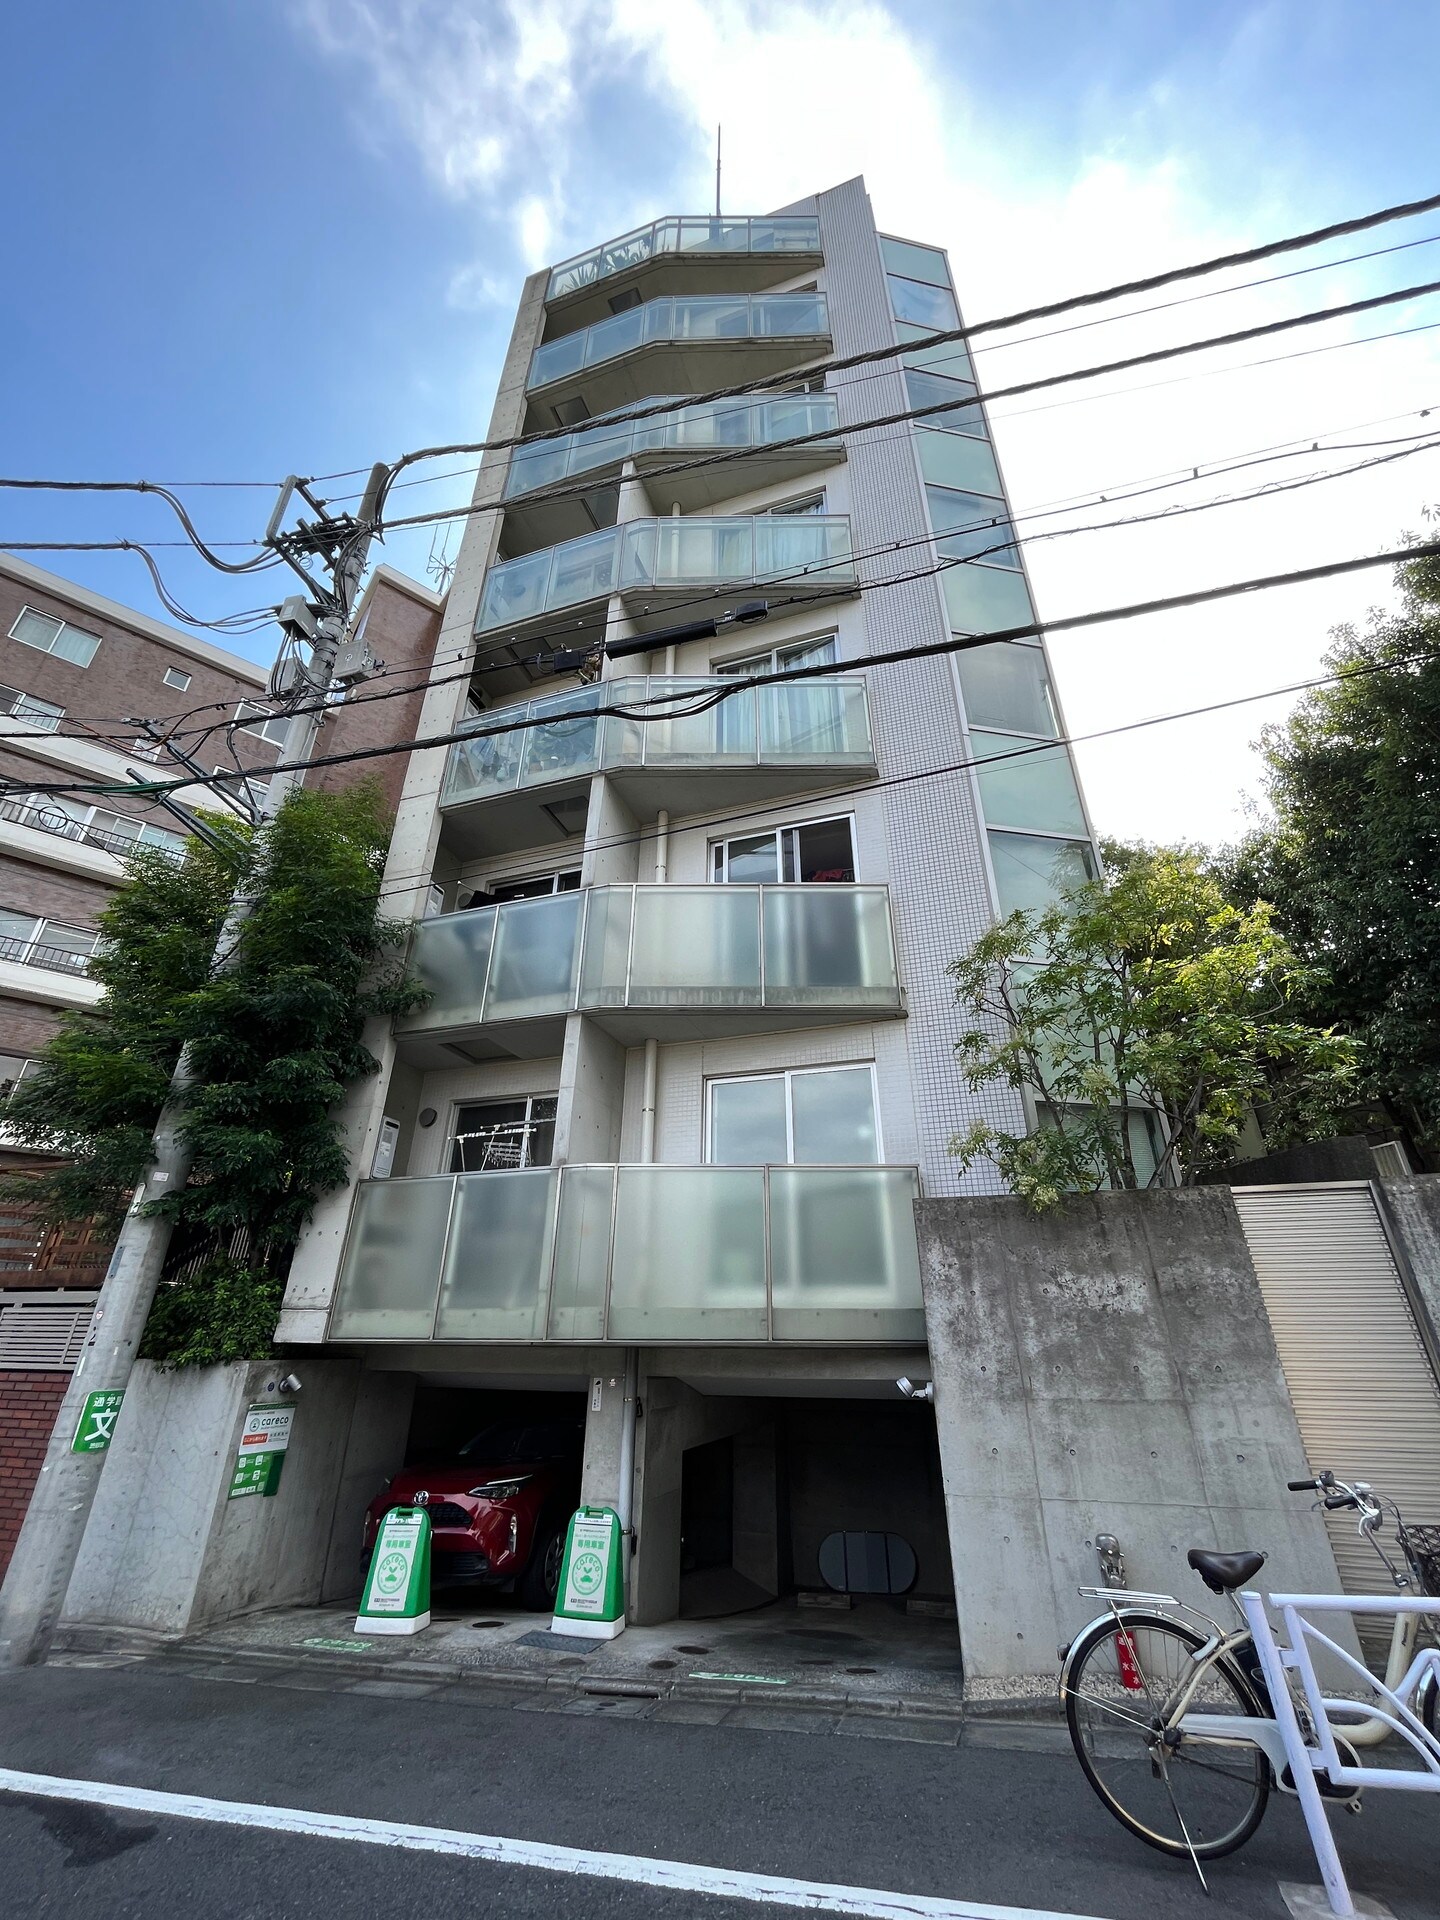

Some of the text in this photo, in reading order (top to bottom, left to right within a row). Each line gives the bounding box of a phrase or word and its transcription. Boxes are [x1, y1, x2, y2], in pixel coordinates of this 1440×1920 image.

[84, 1408, 118, 1442] 文
[261, 1415, 289, 1427] careco
[381, 1554, 405, 1572] careco
[575, 1554, 601, 1573] careco
